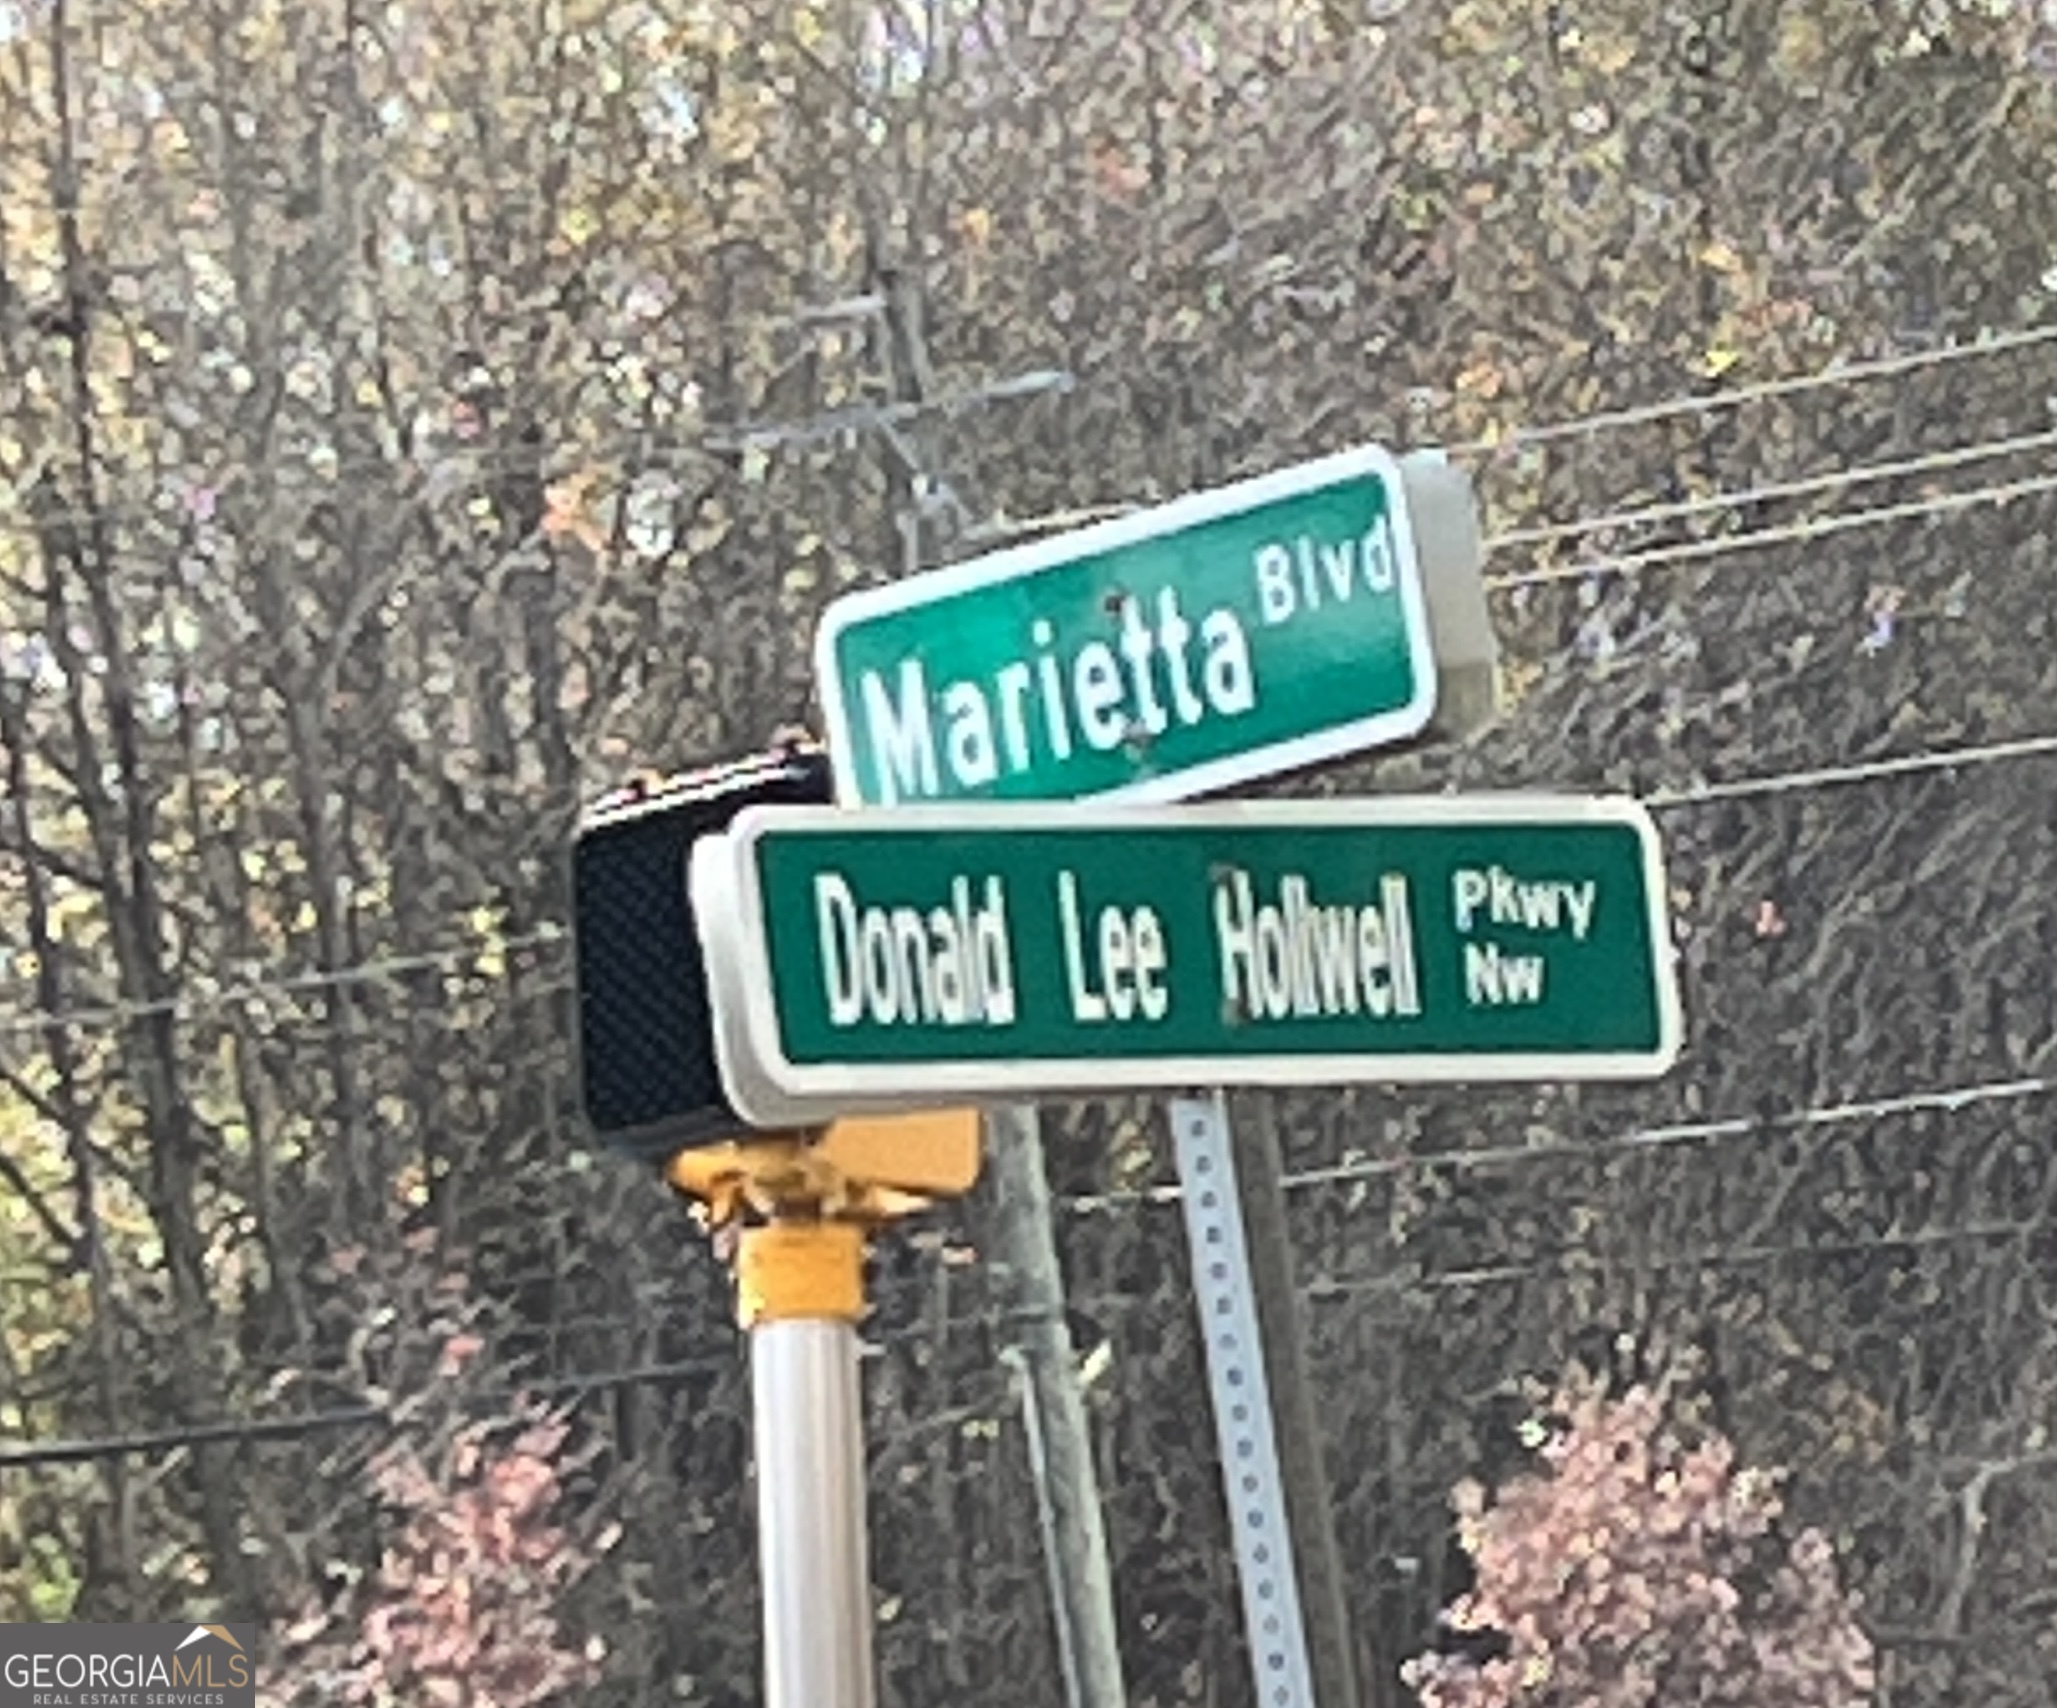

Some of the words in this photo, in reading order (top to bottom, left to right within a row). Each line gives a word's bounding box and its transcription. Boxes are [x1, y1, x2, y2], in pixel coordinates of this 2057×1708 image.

[860, 586, 1254, 808] Marietta
[1254, 514, 1394, 628] Blvd
[814, 874, 1016, 1025] Donald
[1058, 870, 1167, 1020] Lee
[1452, 865, 1596, 940] Pkwy
